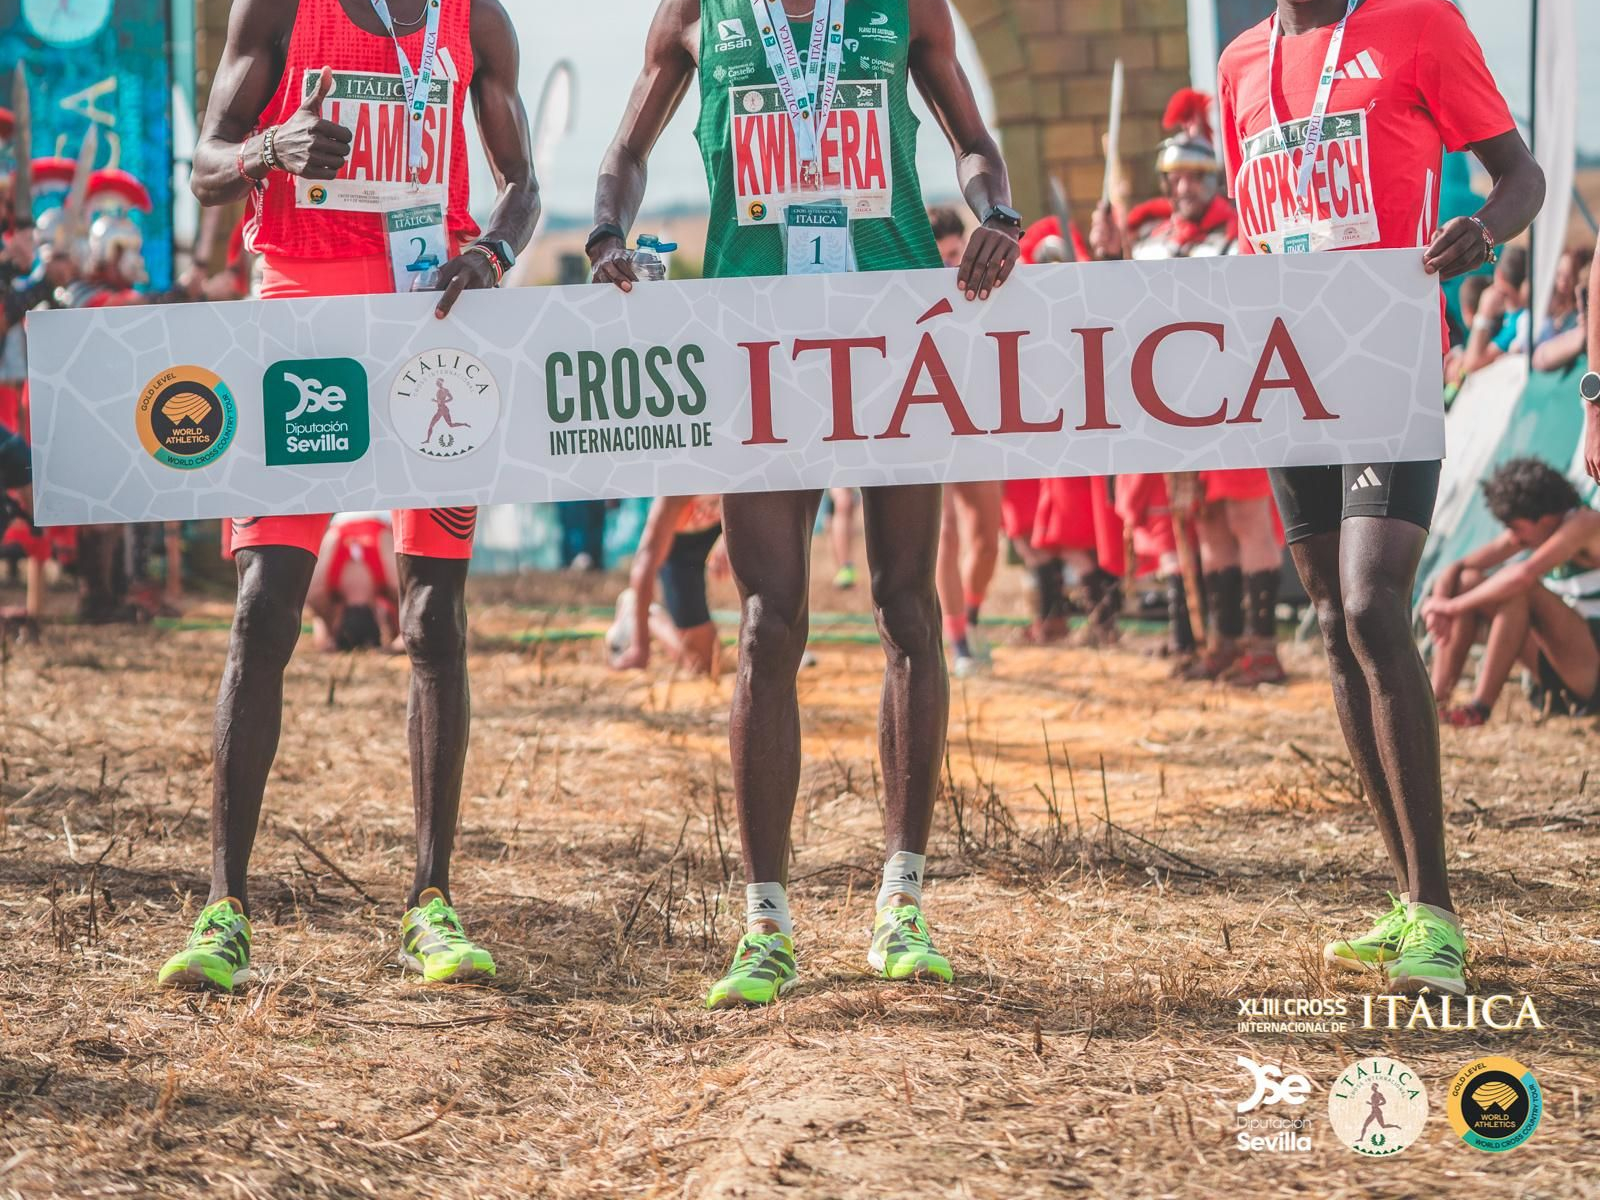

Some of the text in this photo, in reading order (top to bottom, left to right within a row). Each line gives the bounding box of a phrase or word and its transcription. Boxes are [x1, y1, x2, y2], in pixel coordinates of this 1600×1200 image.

[423, 31, 437, 71] ITÁLICA
[715, 38, 752, 53] rasán
[779, 24, 798, 67] ITÁLICA
[810, 18, 825, 60] ITÁLICA
[347, 78, 405, 97] ITÁLIC
[778, 76, 800, 119] ITÁLICA
[319, 101, 447, 184] LAMSI
[1266, 123, 1326, 148] ITLIC
[1305, 114, 1320, 156] ITÁLICA
[396, 214, 433, 229] ITÁLICA
[796, 213, 837, 225] ITÁLICA
[409, 237, 428, 262] 2
[809, 236, 824, 264] 1
[397, 354, 489, 397] ITÁLICA
[545, 343, 707, 424] CROSS
[736, 298, 1341, 445] ITÁLICA
[141, 373, 177, 411] GOLD LEVEL
[165, 435, 210, 444] ATHLETICS
[167, 393, 234, 466] WORLD CROSS COUNTRY TOUR
[172, 428, 203, 436] WORLD
[285, 421, 348, 435] Diputación
[286, 434, 349, 453] Sevilla
[550, 422, 713, 456] INTERNACIONAL DE
